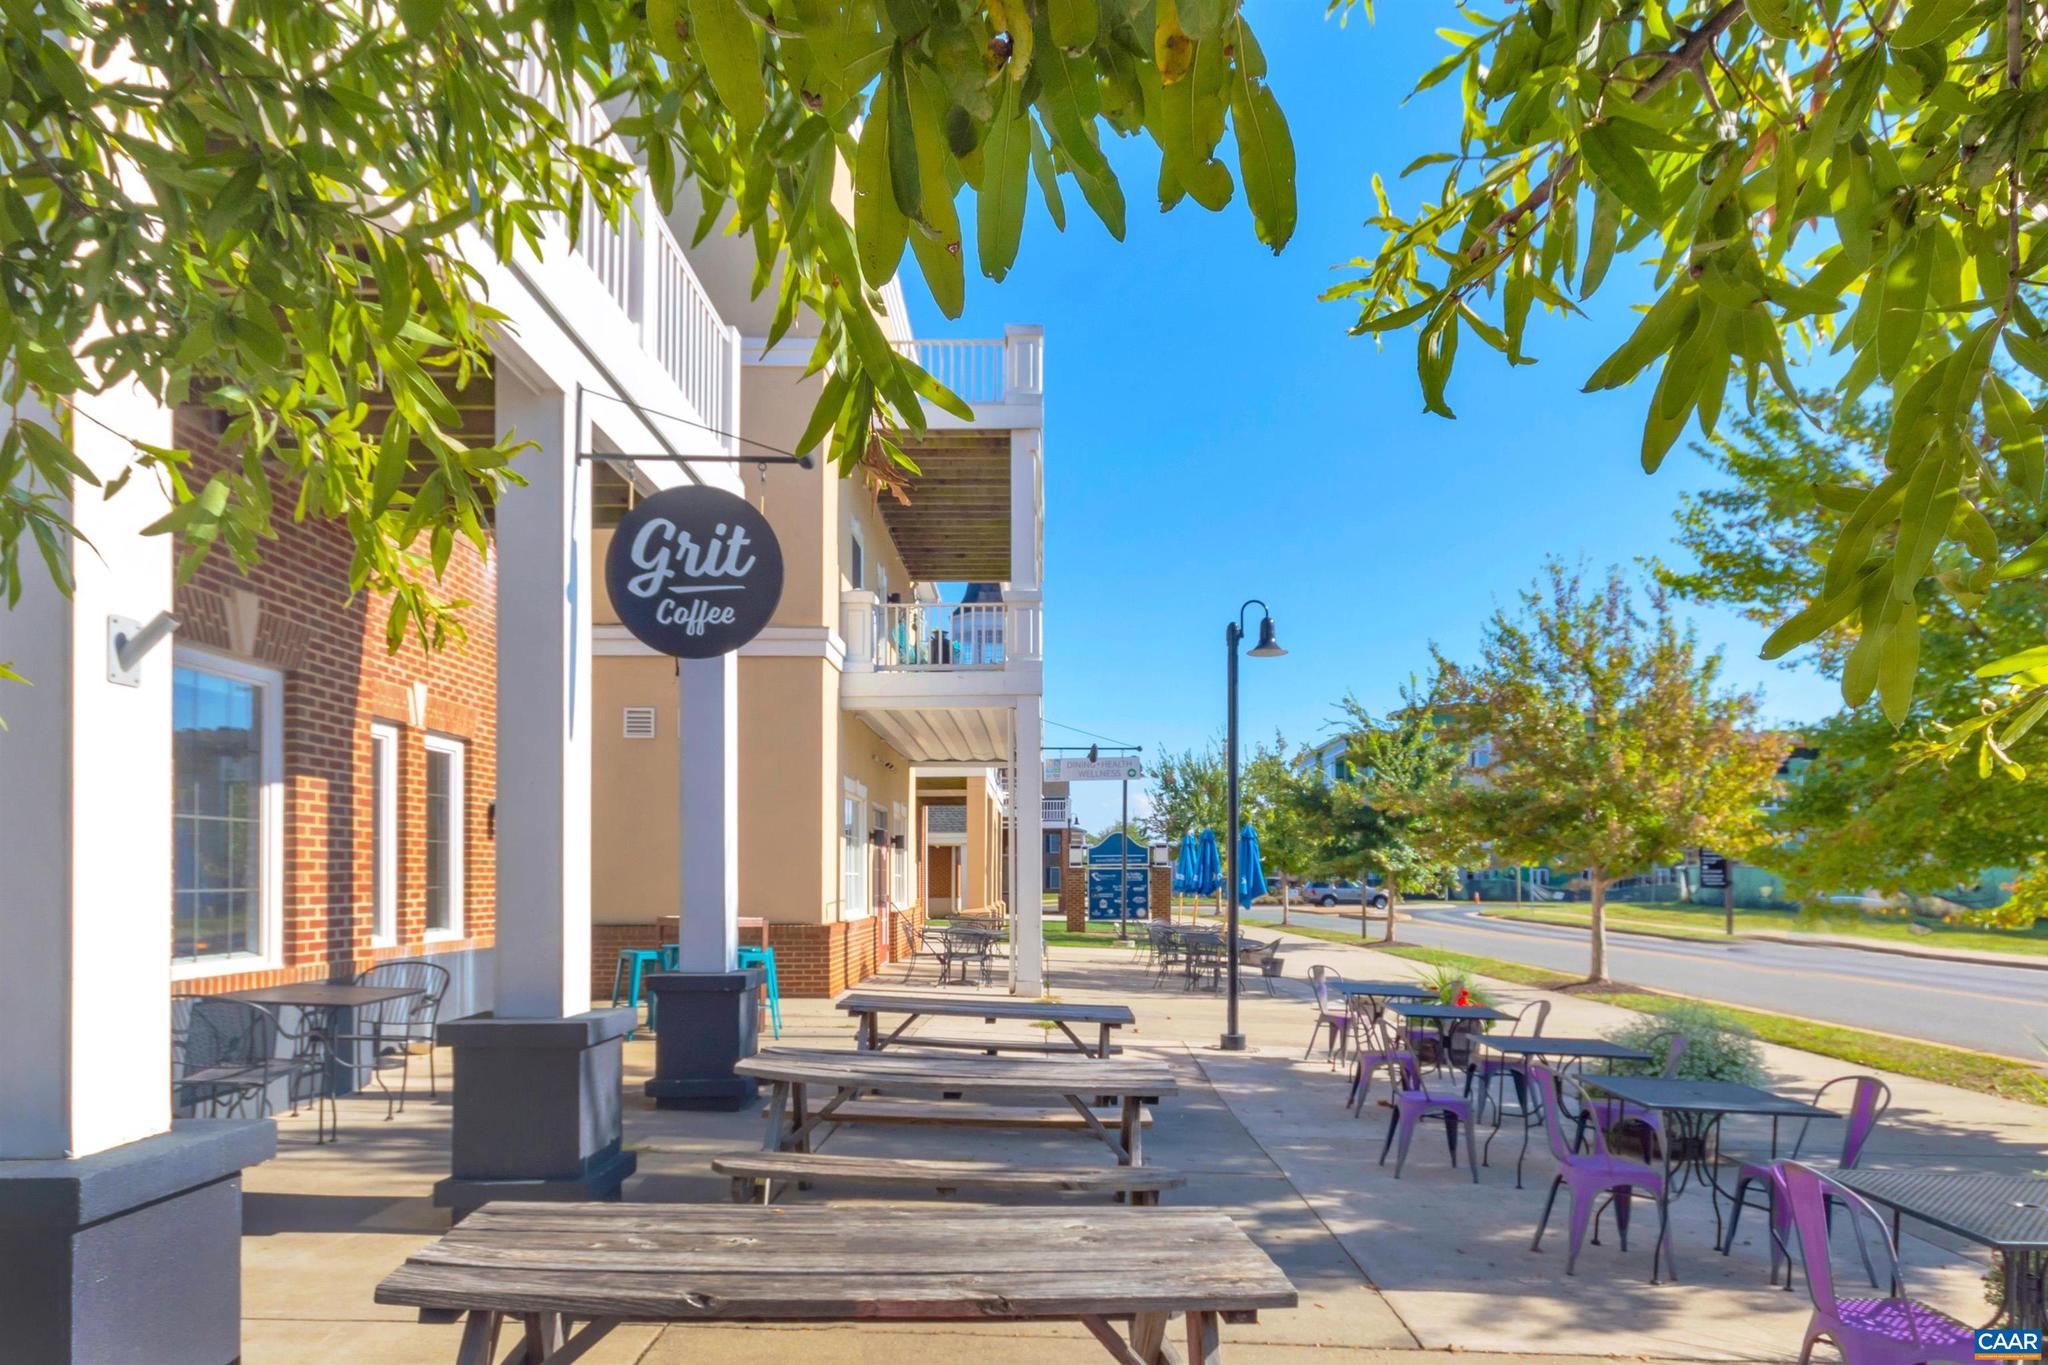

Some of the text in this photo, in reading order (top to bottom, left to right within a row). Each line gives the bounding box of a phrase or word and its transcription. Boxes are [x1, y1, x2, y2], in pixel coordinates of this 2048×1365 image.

[627, 517, 757, 598] Grit
[656, 598, 736, 636] Coffee
[1078, 769, 1121, 778] WELLNESS
